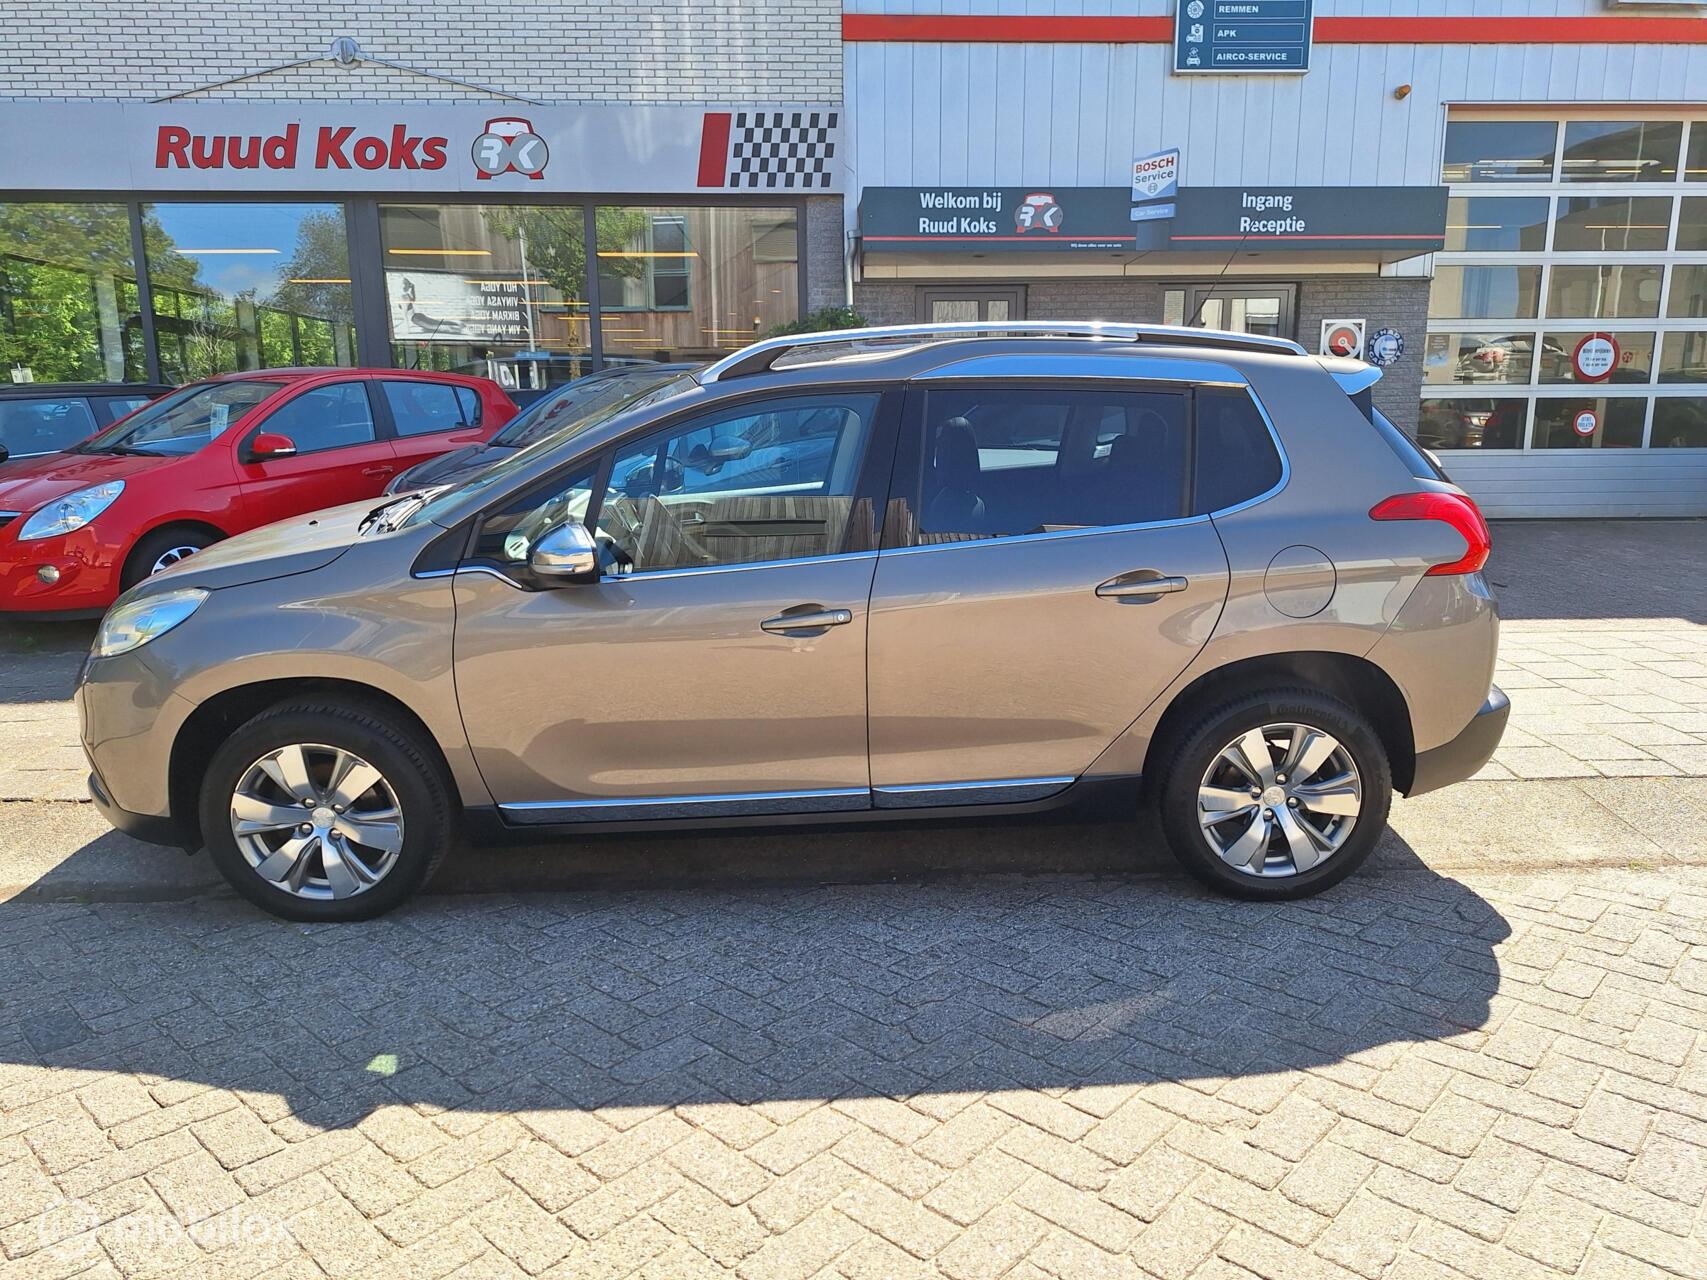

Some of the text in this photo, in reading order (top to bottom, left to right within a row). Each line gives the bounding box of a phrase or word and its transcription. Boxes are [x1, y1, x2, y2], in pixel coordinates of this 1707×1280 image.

[1218, 5, 1259, 13] REMMEN
[1217, 29, 1237, 37] APK
[1216, 52, 1288, 61] AIRCO-SERVICE
[155, 123, 449, 170] Ruud Koks
[1135, 156, 1175, 174] BOSCH
[1135, 169, 1174, 184] Service
[920, 191, 1002, 212] Welkom bij
[1242, 192, 1293, 212] Ingang
[919, 217, 997, 234] Ruud Koks
[1240, 215, 1306, 235] Receptie
